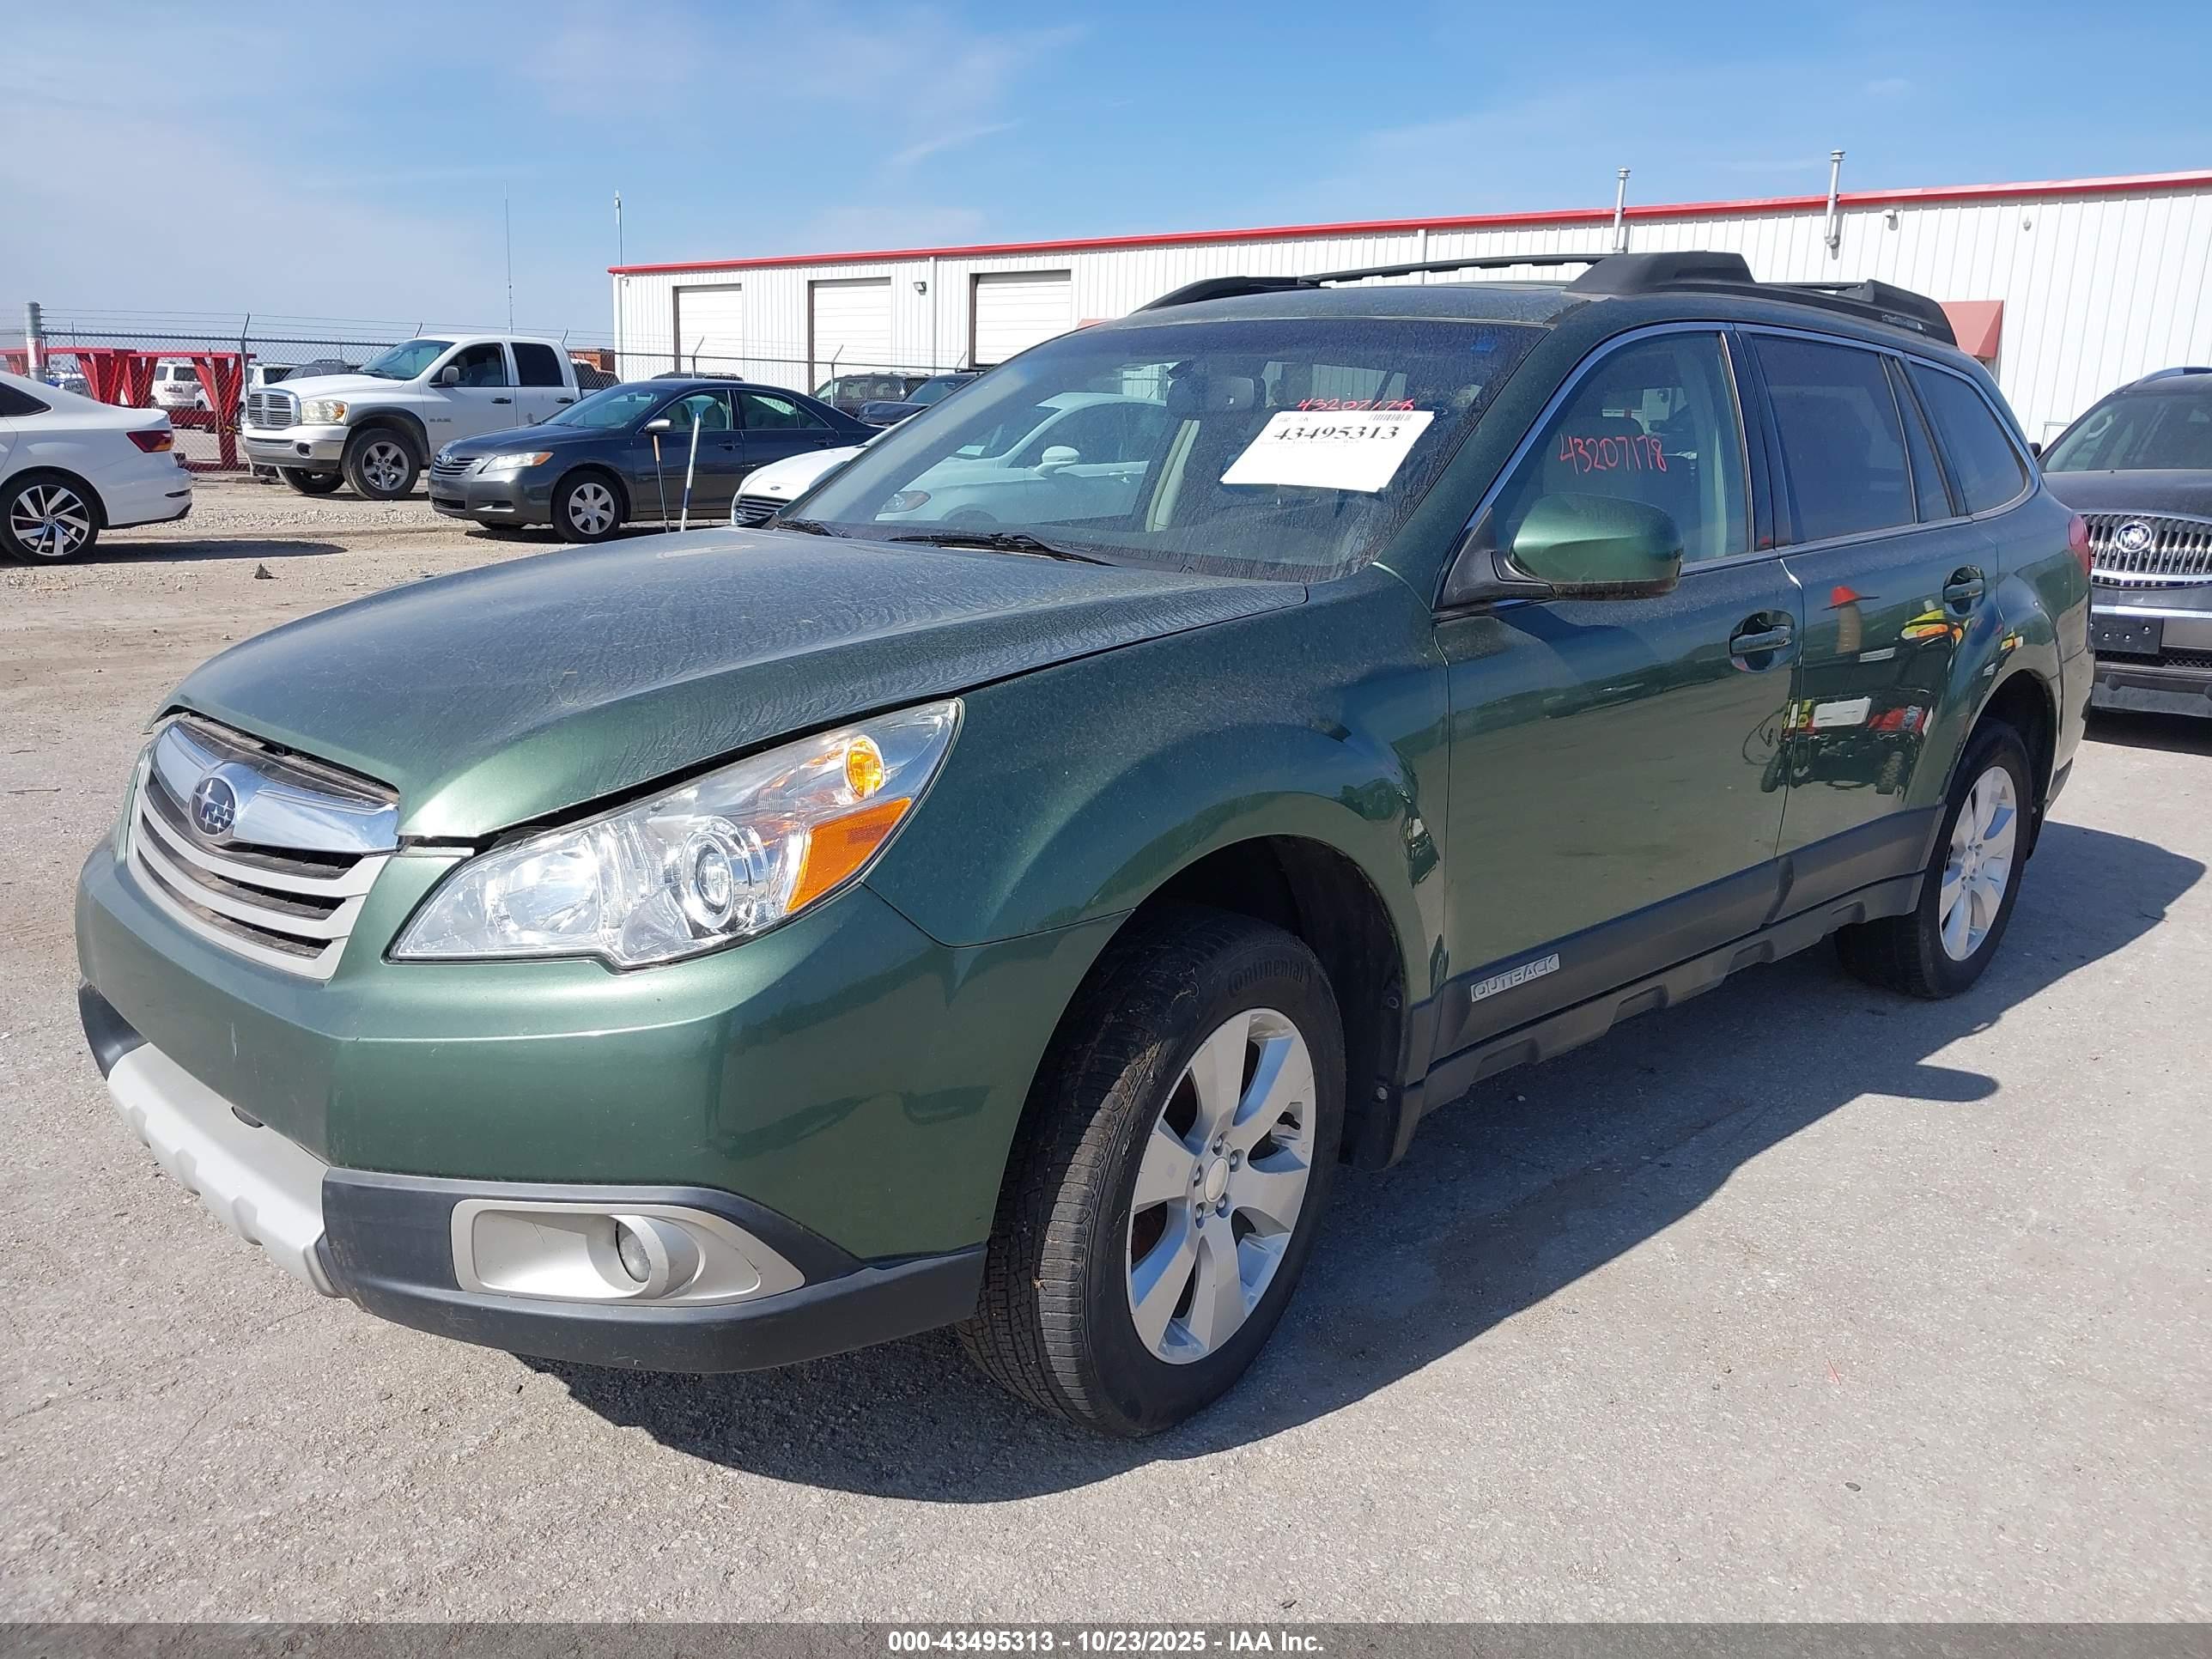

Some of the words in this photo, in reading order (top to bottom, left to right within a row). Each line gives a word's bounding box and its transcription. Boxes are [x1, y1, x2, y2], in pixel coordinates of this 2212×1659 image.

[1274, 426, 1401, 441] 43495313
[1559, 433, 1668, 475] 43207178
[1471, 954, 1559, 1000] OUTBACK
